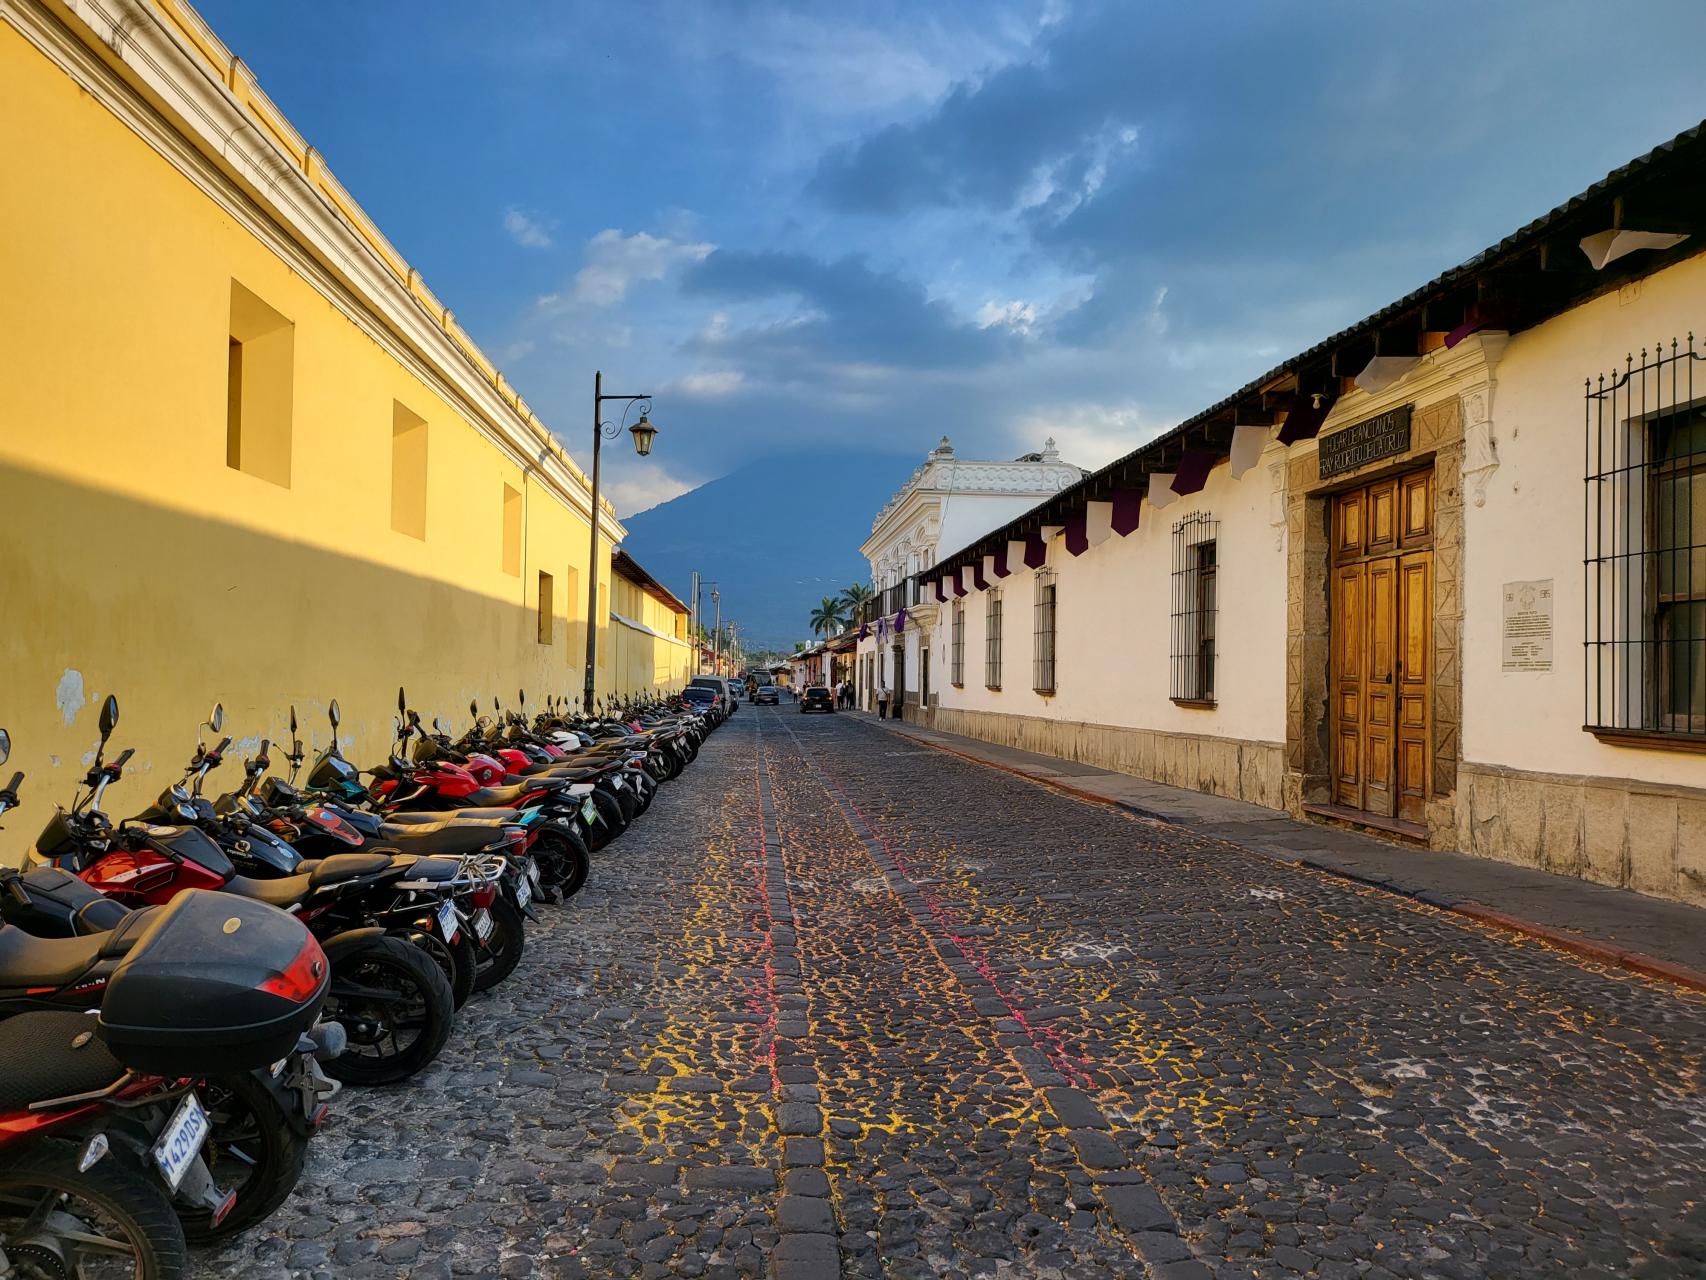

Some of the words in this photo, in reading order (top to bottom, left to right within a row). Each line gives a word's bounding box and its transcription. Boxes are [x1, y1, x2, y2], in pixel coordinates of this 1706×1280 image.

[1320, 457, 1334, 475] FRAY
[1334, 446, 1363, 470] RODRIGO
[1363, 442, 1373, 461] DE
[1374, 439, 1383, 456] LA
[1384, 430, 1405, 452] CRUZ
[1327, 431, 1348, 454] HOGAR
[1348, 428, 1358, 446] DE
[1358, 413, 1395, 441] ANCIANOS
